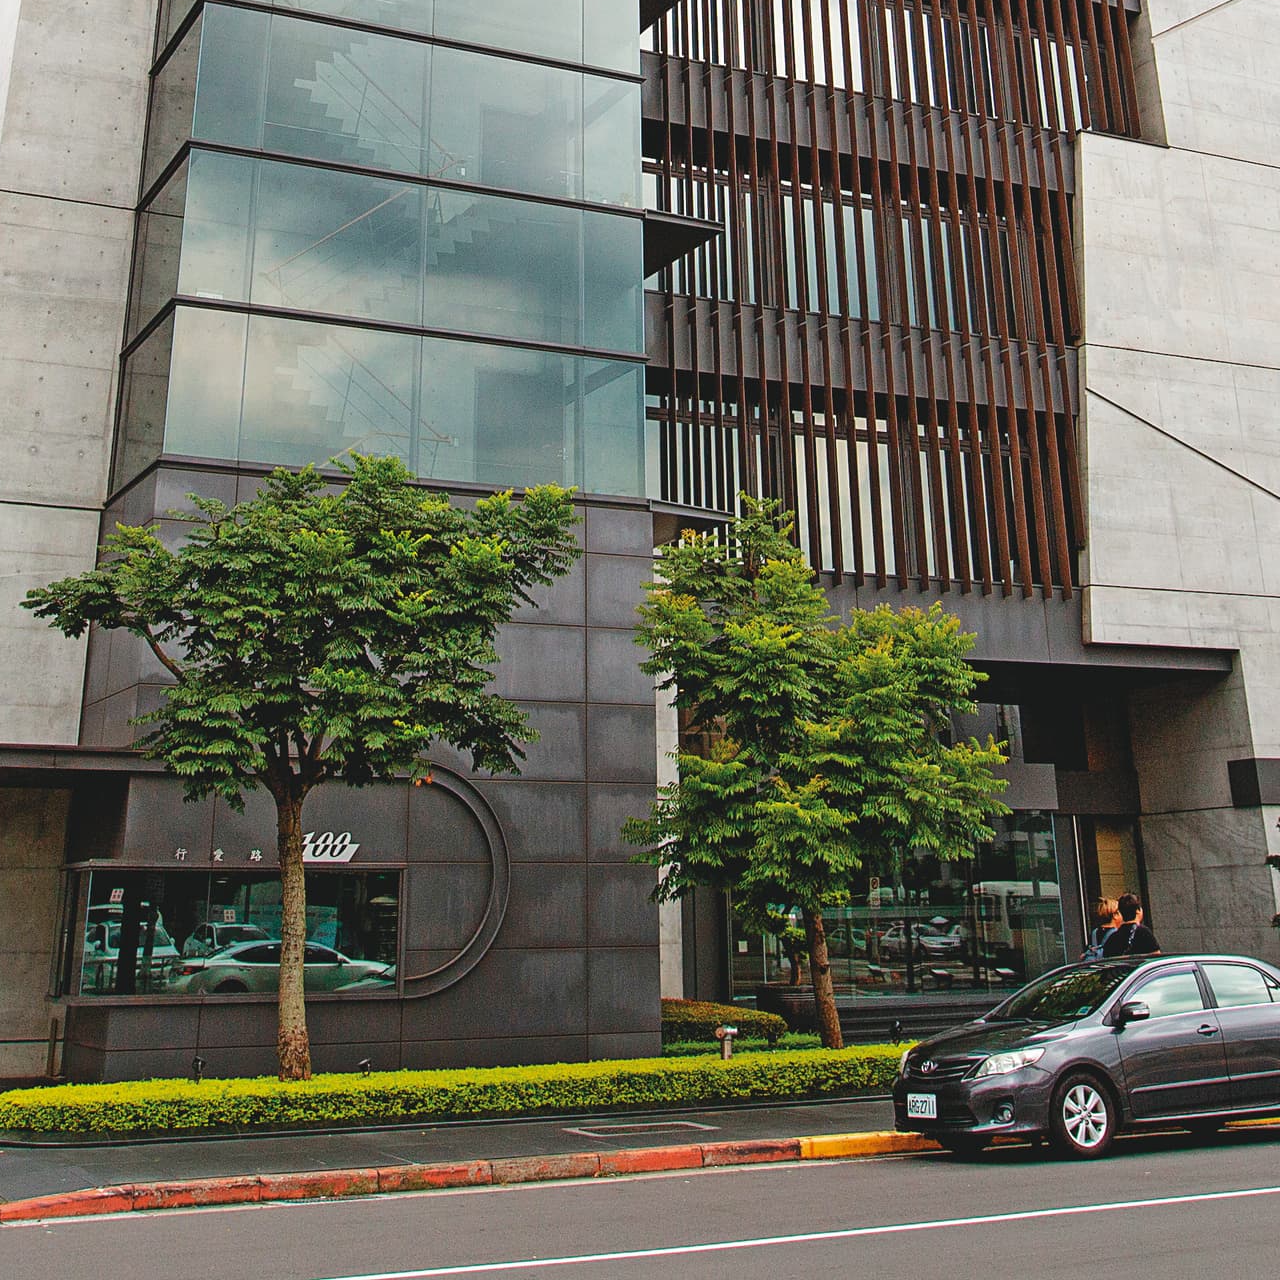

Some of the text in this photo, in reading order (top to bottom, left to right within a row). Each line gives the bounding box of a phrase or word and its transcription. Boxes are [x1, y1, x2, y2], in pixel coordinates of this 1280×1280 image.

[175, 831, 352, 862] 行愛路 100
